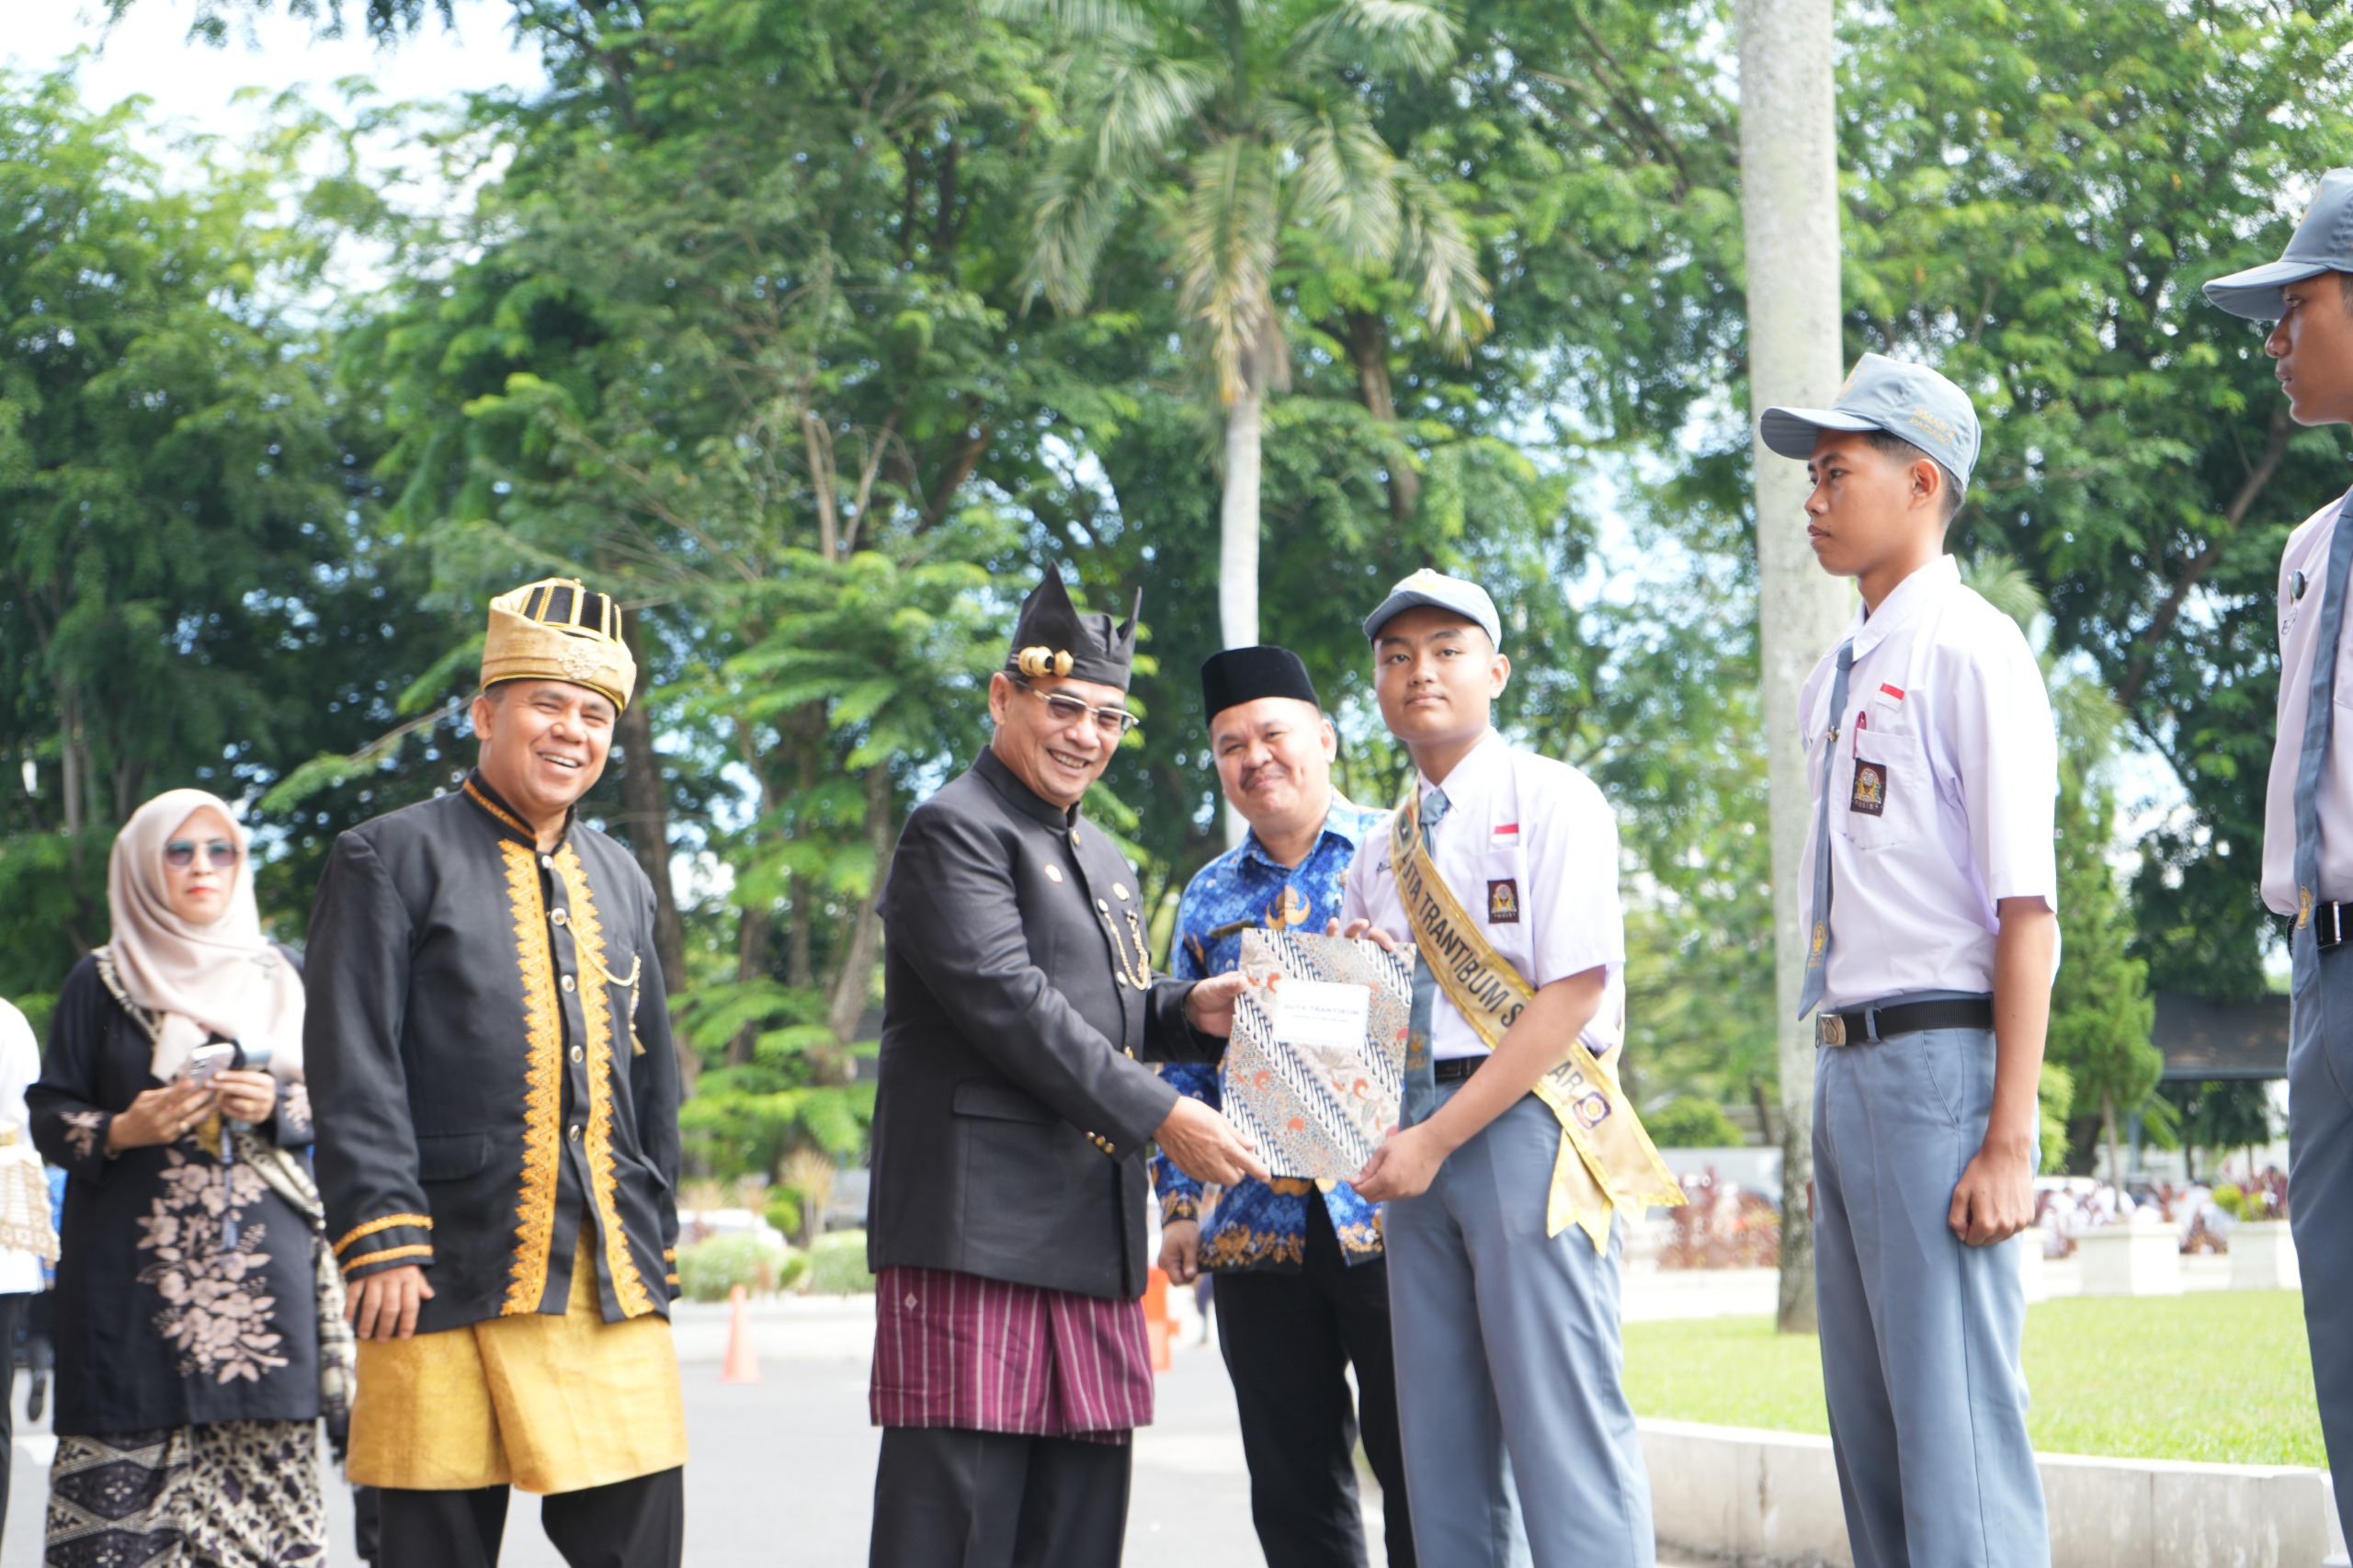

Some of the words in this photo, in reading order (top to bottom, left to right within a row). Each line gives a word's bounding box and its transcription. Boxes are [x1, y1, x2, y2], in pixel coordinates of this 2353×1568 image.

[1909, 417, 1950, 447] PADANG
[1419, 892, 1509, 1014] TRANTIBUM
[1310, 1006, 1359, 1016] TRANTIBUM
